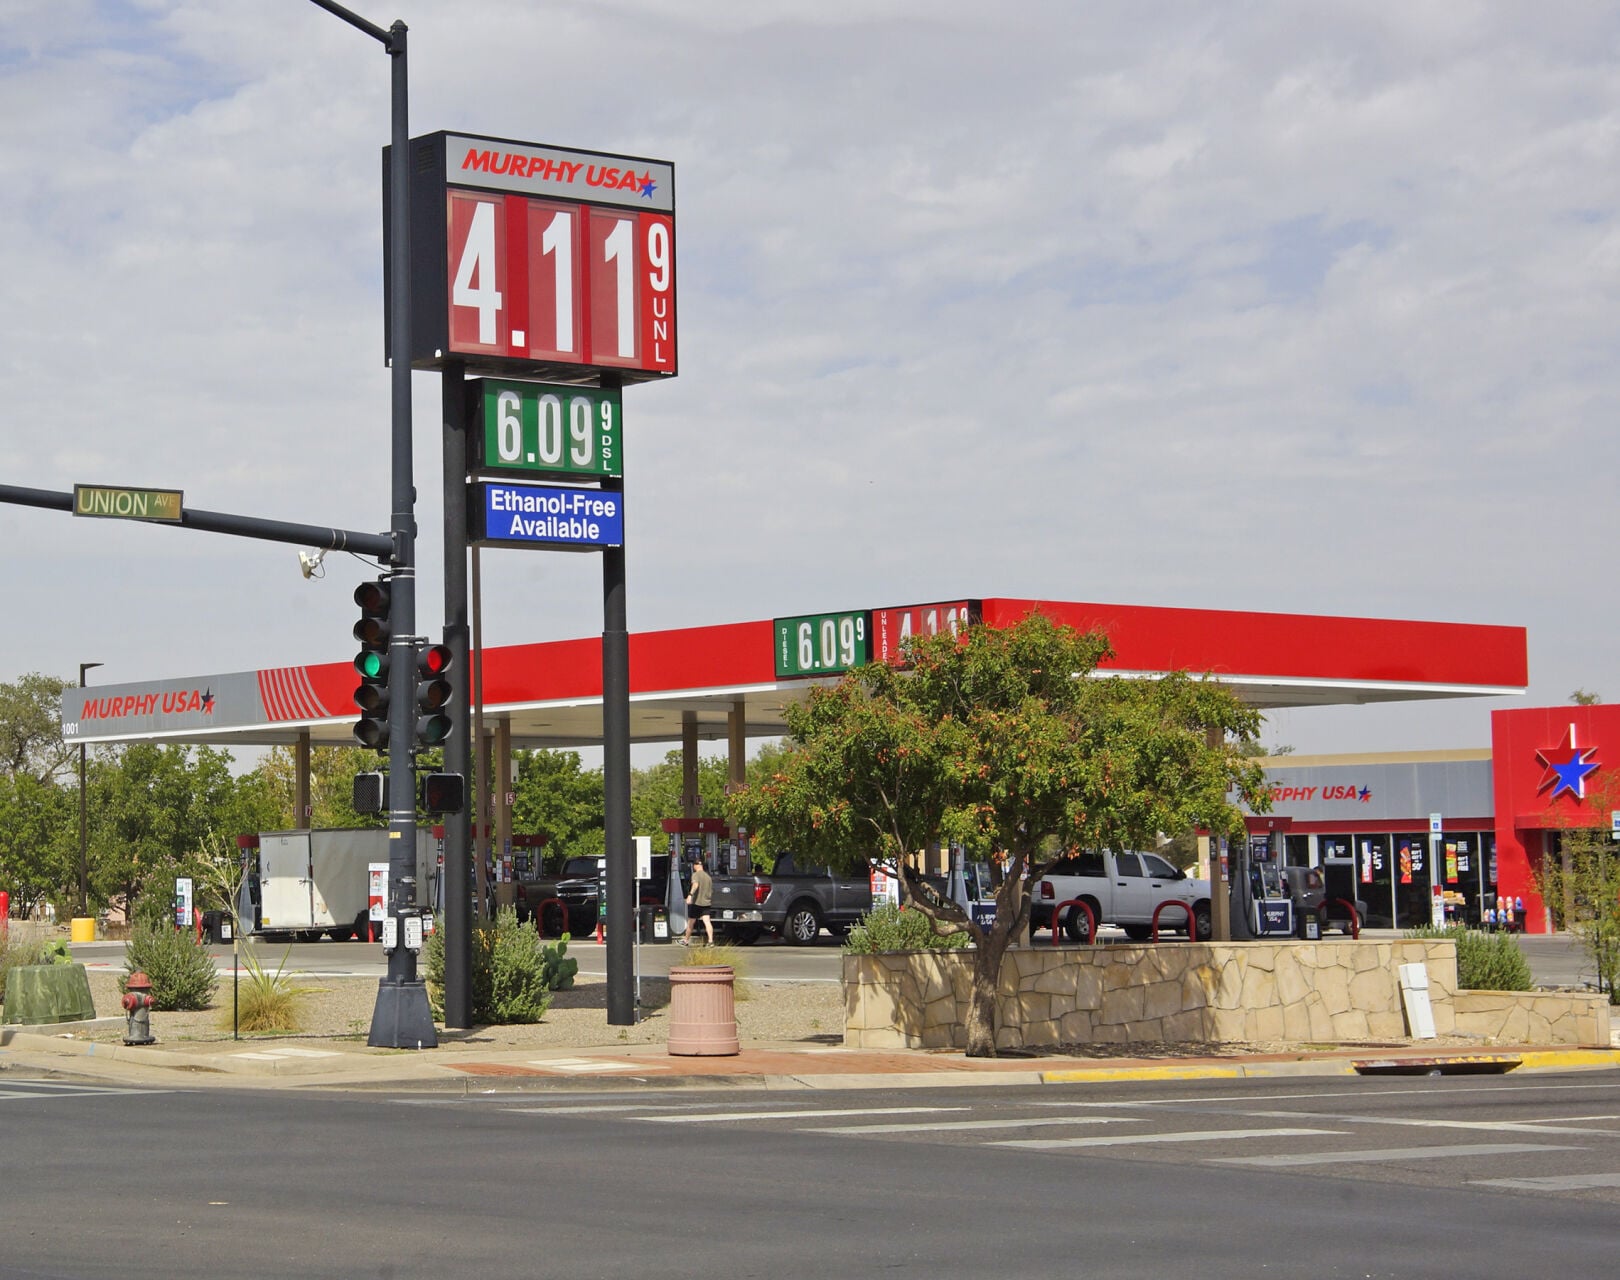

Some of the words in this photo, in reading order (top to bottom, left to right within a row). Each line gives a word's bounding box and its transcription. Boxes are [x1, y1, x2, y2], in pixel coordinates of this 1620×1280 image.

[462, 148, 584, 183] MURPHY
[585, 165, 638, 193] USA
[653, 297, 667, 363] UNL
[602, 435, 612, 471] DSL
[80, 489, 148, 516] UNION
[154, 494, 176, 507] AVE
[491, 489, 616, 517] Ethanol-Free
[510, 514, 600, 540] Available
[81, 693, 160, 720] MURPHY
[162, 690, 200, 714] USA
[1243, 786, 1318, 801] RPHY
[1322, 785, 1357, 800] USA
